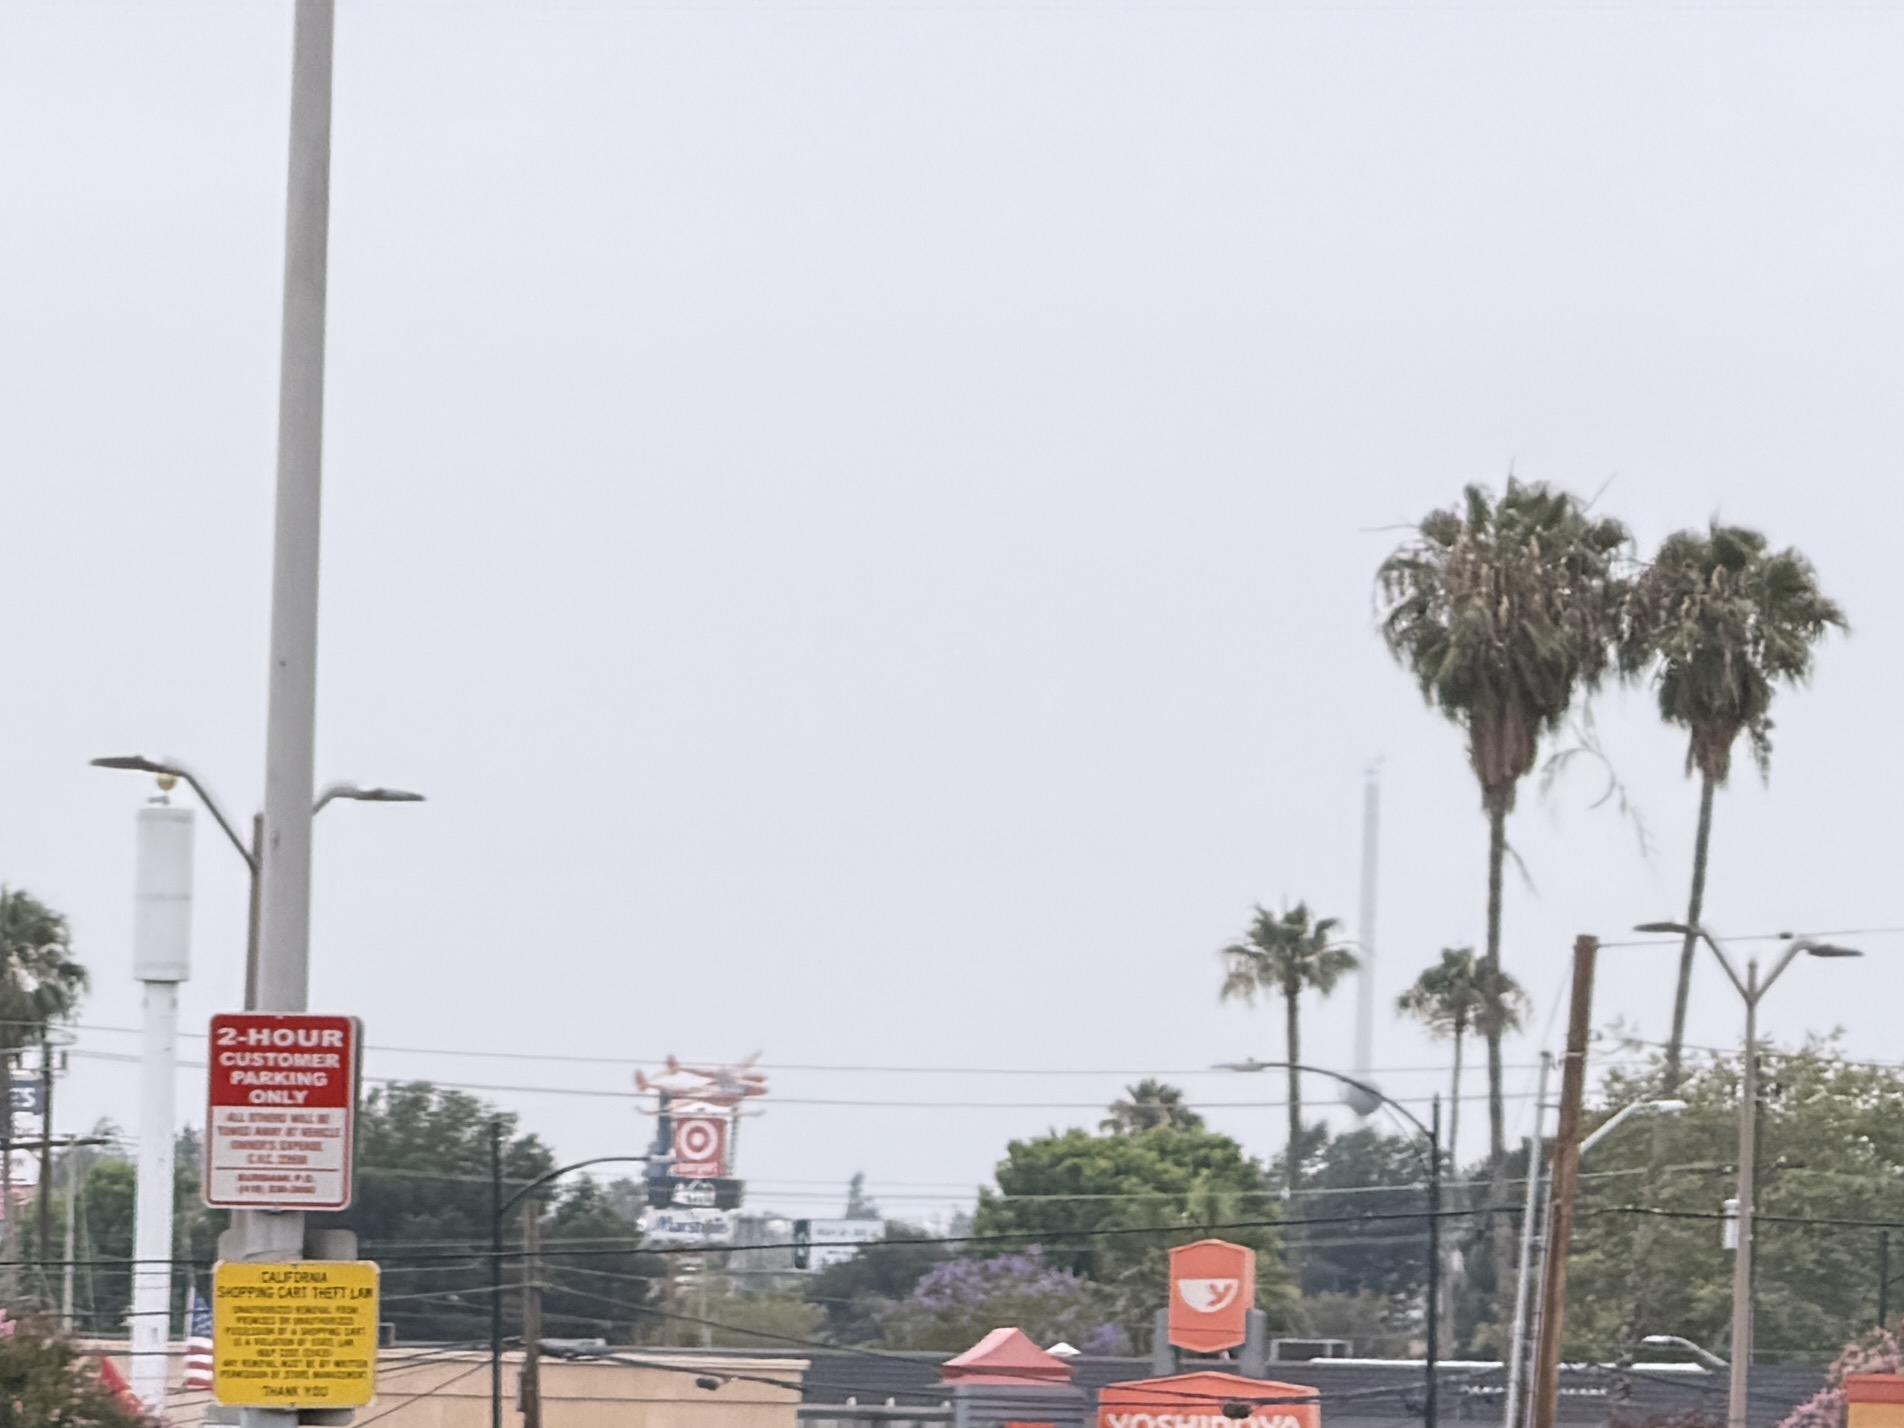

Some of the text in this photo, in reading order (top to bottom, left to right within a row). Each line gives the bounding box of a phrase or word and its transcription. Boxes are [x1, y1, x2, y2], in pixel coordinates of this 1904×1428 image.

[216, 1027, 344, 1047] 2-HOUR
[219, 1051, 341, 1068] CUSTOMER
[229, 1070, 328, 1087] PARKING
[248, 1089, 309, 1105] ONLY
[261, 1271, 329, 1283] CALIFORNIA
